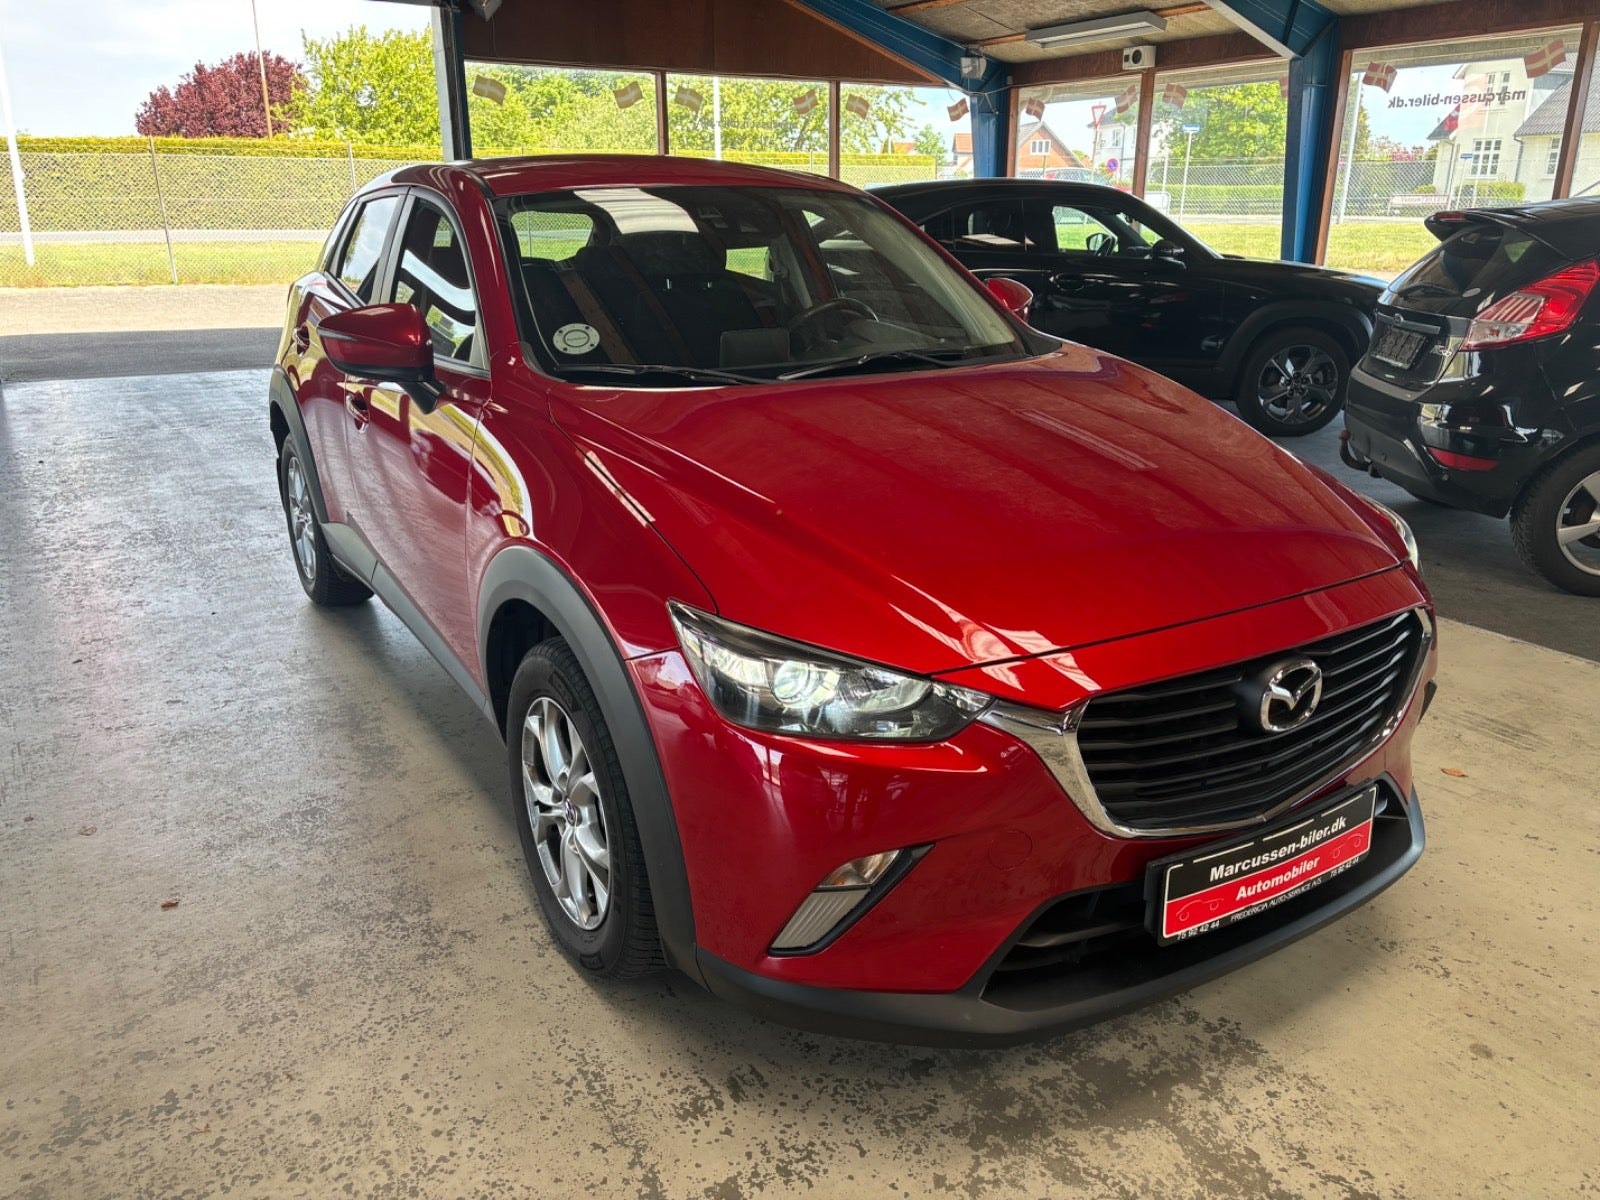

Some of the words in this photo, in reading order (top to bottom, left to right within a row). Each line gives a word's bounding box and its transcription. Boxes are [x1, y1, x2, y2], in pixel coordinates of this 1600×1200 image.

[1209, 816, 1347, 882] Marcussen-biler.dk
[1235, 857, 1320, 901] Automobiler
[1210, 919, 1220, 929] 44
